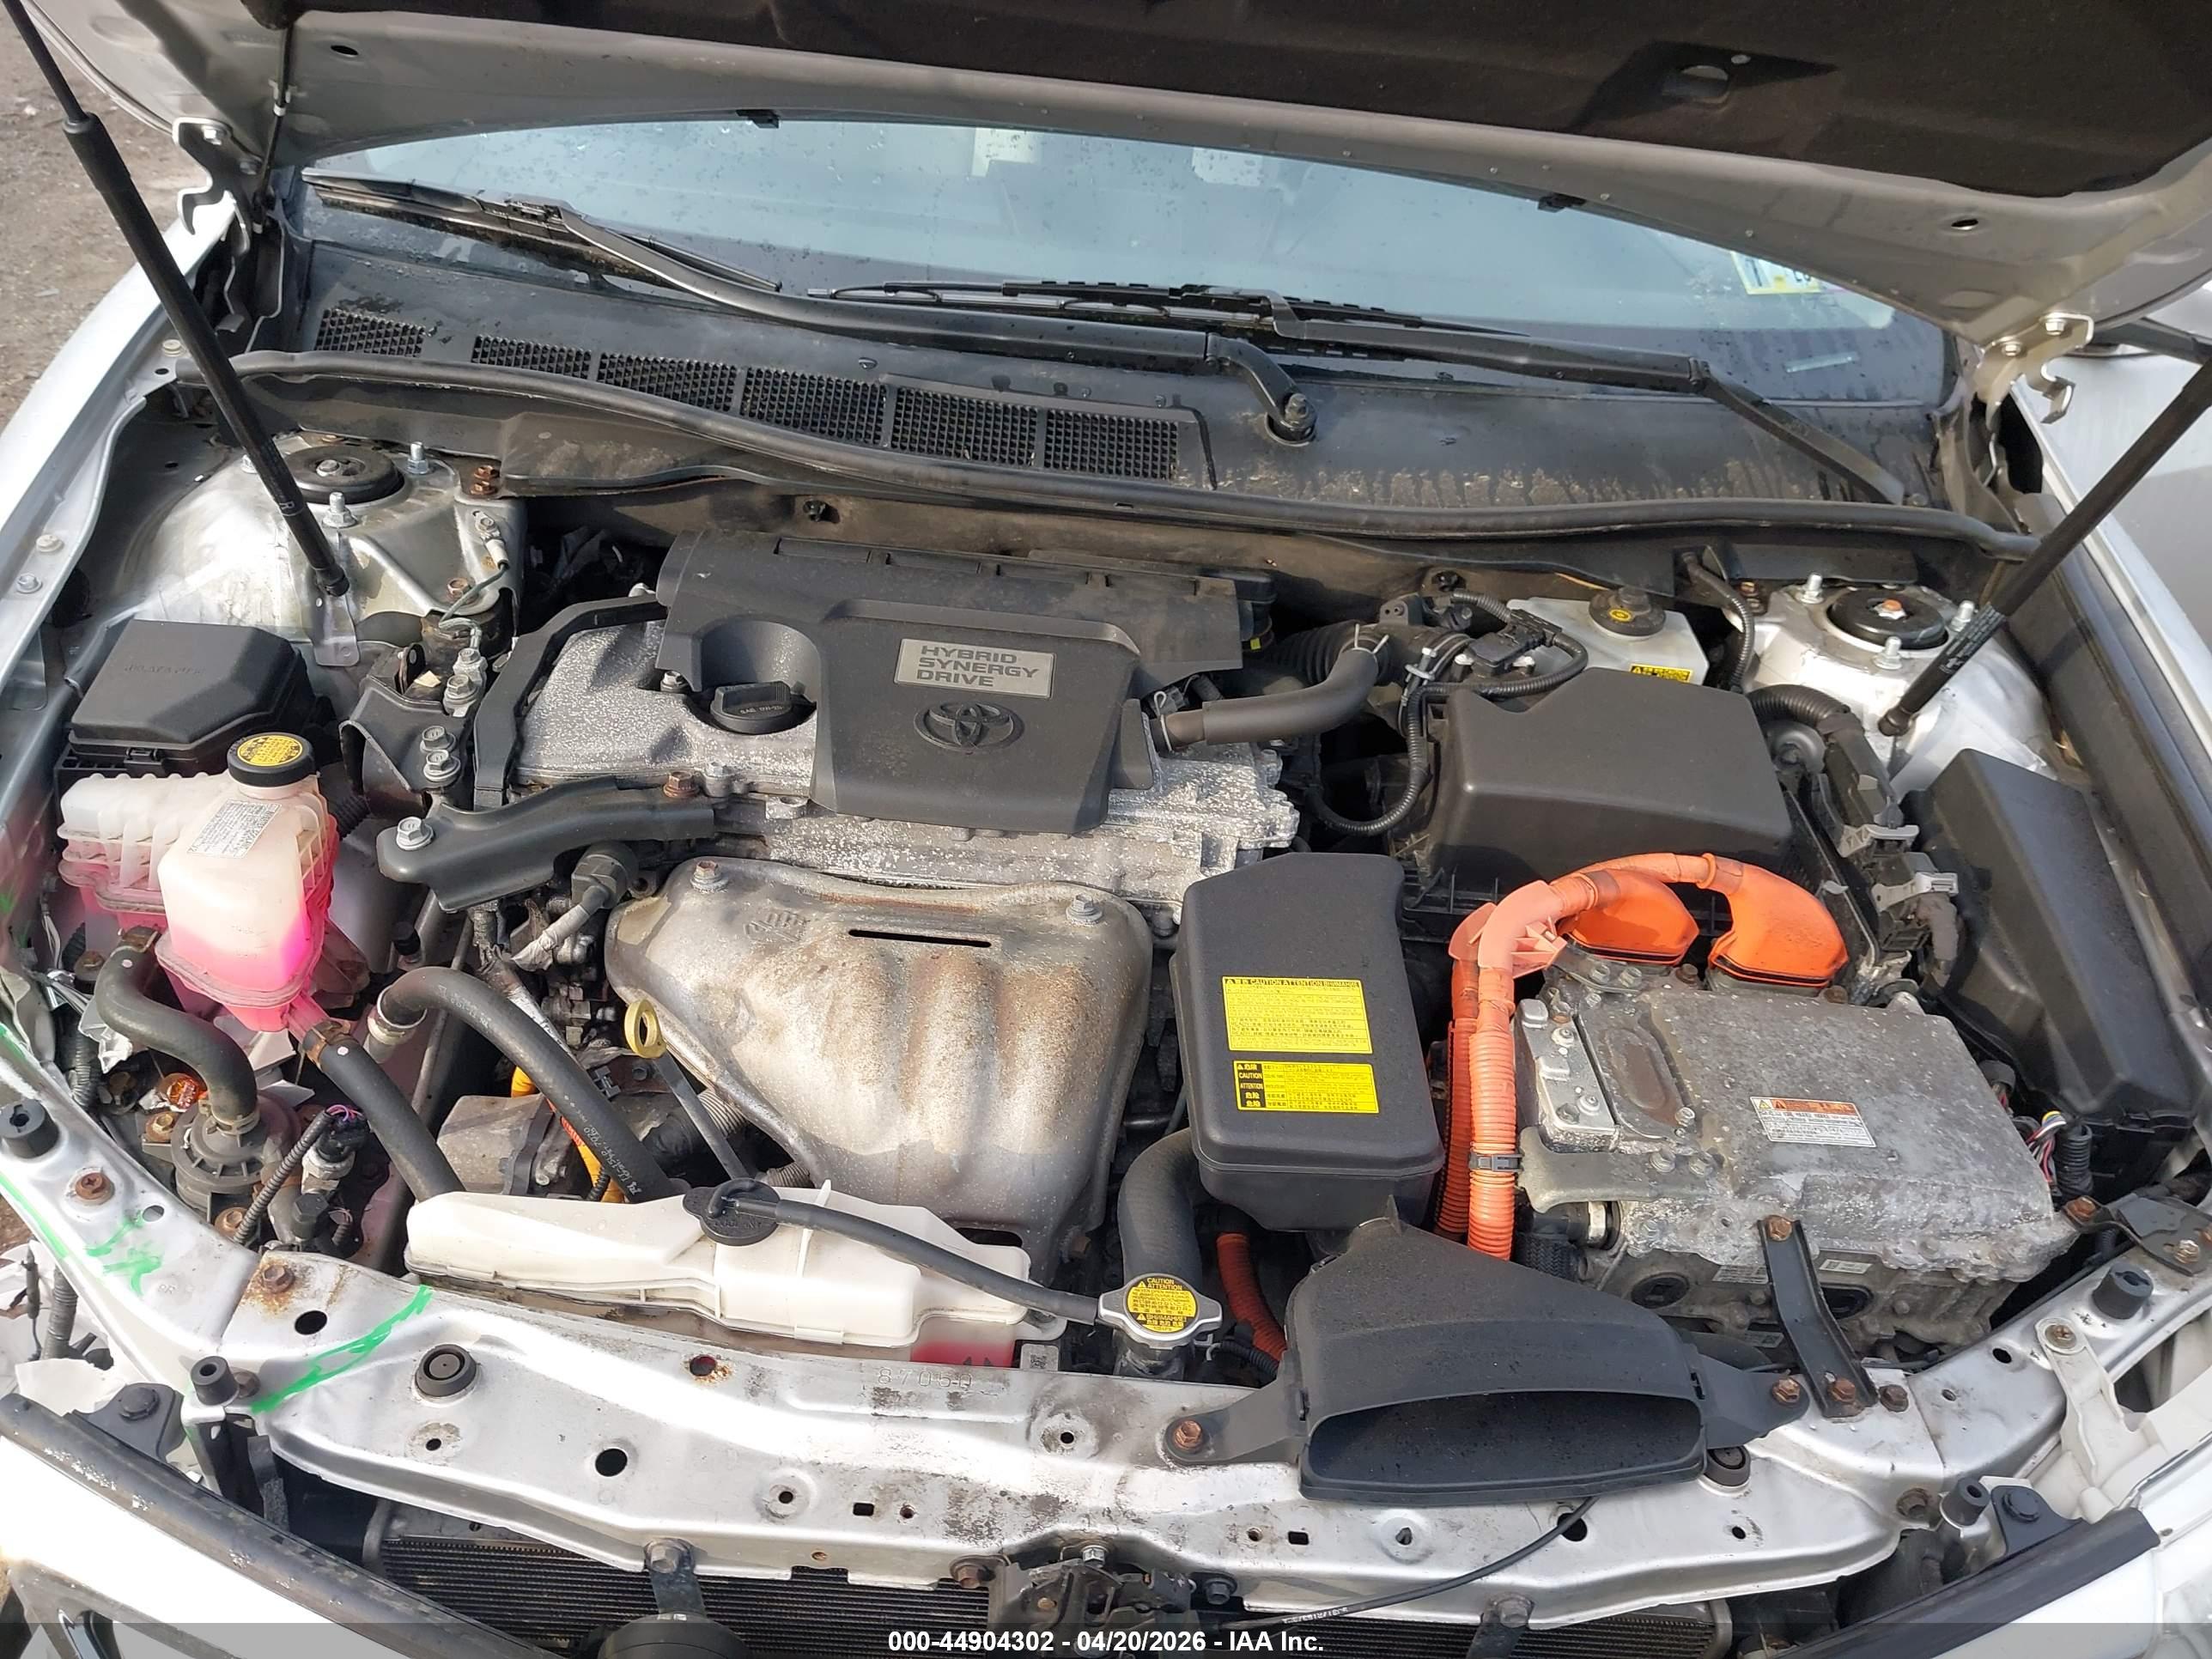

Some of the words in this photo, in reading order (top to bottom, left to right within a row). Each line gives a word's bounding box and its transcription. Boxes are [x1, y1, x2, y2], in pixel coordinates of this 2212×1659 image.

[921, 645, 1018, 665] HYBRID
[918, 657, 1041, 678] SYNERGY
[916, 669, 995, 687] DRIVE
